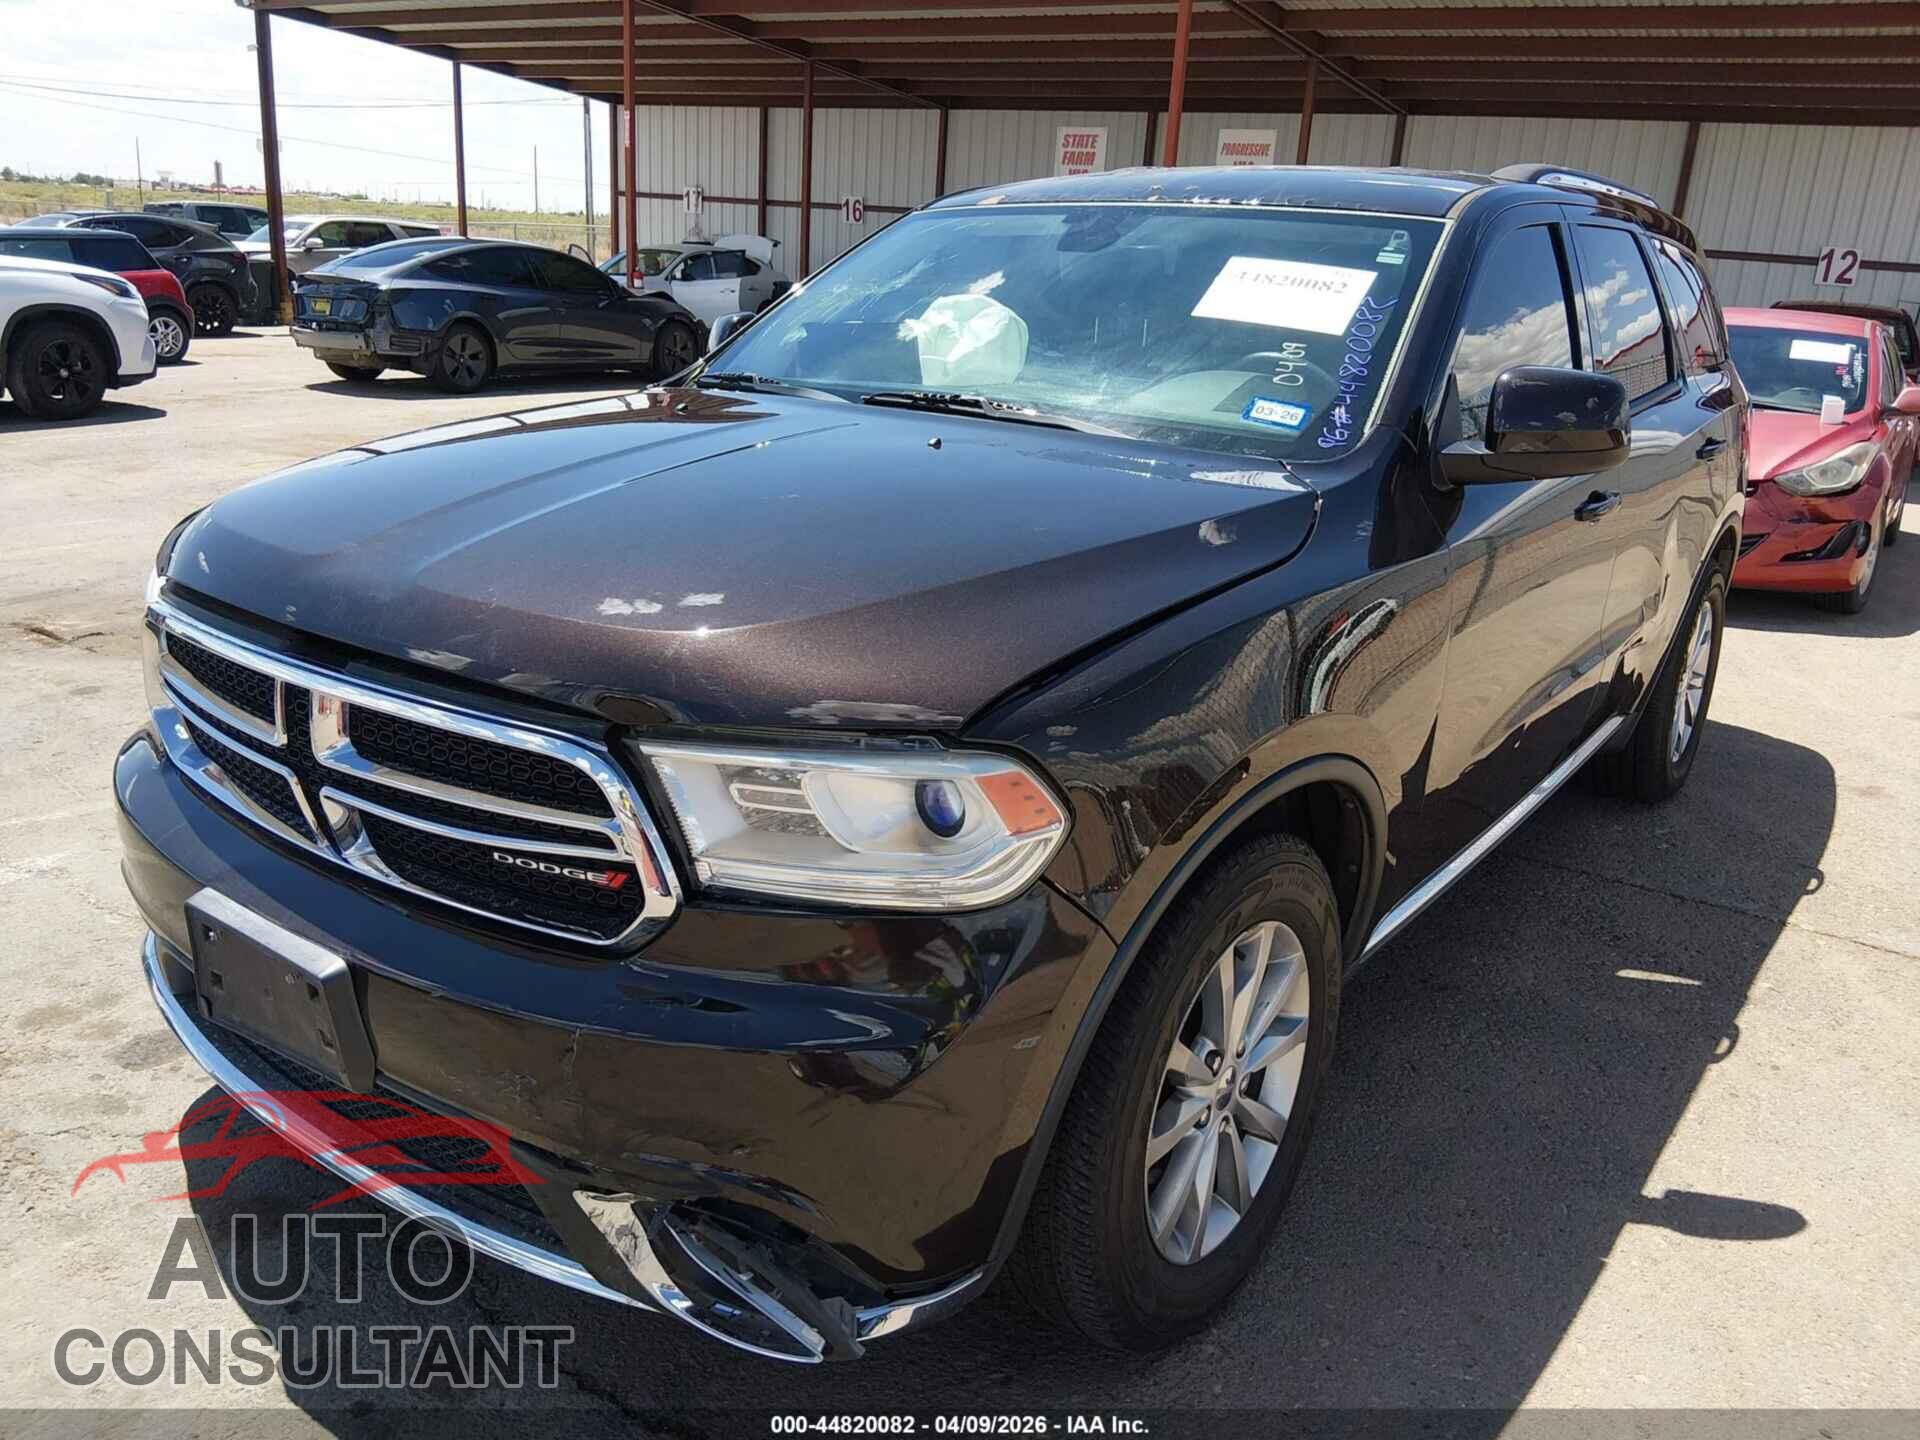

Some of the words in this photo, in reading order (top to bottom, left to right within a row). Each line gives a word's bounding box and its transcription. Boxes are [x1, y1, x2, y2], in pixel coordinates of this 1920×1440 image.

[1062, 133, 1099, 150] STATE
[1220, 142, 1271, 157] PROGRESSIVE
[1061, 151, 1096, 166] FARM
[842, 198, 862, 222] 16
[1820, 248, 1858, 284] 12
[493, 852, 609, 884] DODGE
